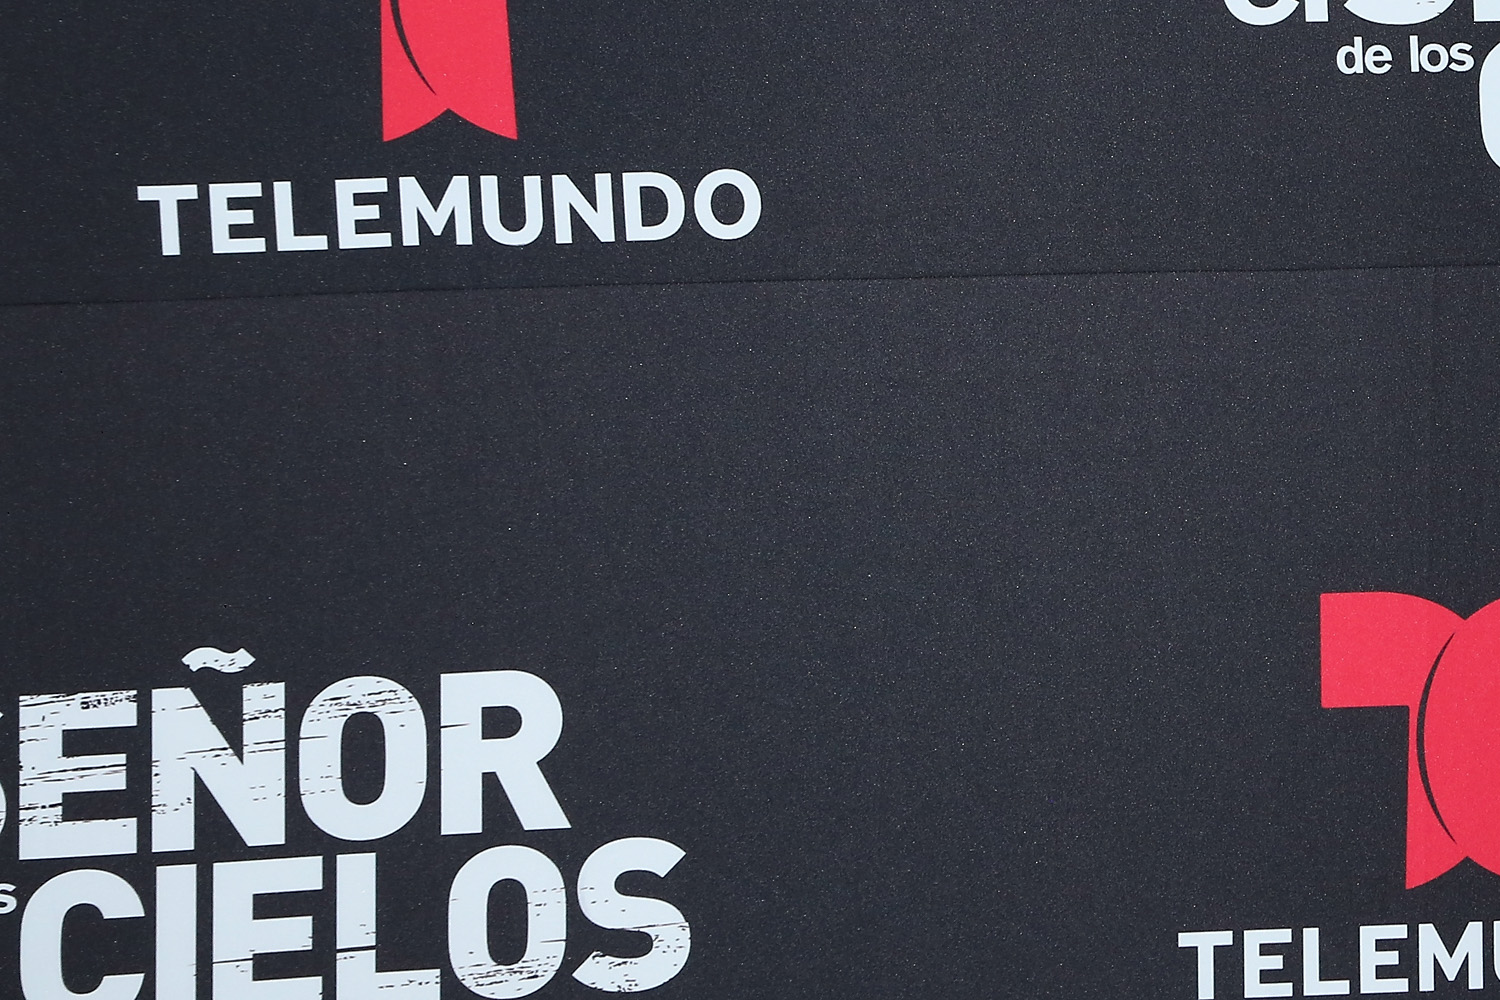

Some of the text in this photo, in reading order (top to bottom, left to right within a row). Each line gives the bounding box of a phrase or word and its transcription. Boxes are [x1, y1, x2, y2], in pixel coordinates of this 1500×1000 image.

[1336, 34, 1474, 75] de los
[137, 169, 761, 256] TELEMUNDO
[0, 647, 571, 861] EÑOR
[20, 836, 691, 1000] CIELOS
